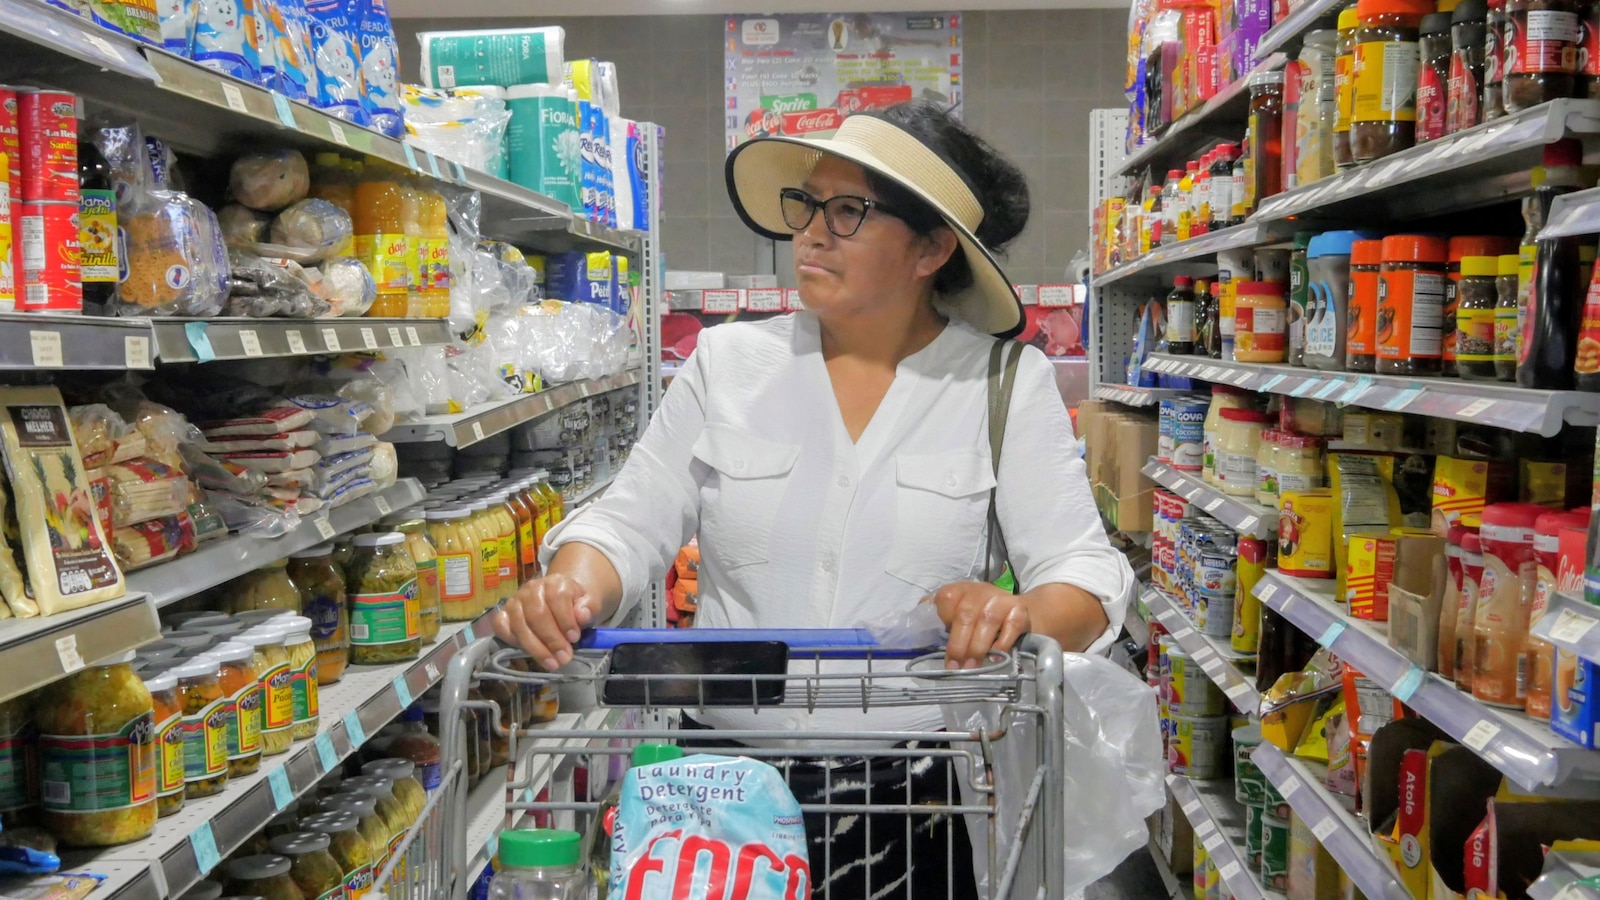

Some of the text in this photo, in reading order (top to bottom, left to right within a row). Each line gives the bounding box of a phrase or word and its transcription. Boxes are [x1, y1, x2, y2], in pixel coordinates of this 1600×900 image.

[771, 98, 811, 115] Sprite
[21, 407, 50, 420] CHOCO
[1177, 412, 1204, 423] GOYA
[636, 765, 746, 786] Laundry
[640, 782, 746, 803] Detergent
[1405, 770, 1416, 815] Atole
[650, 813, 683, 829] para
